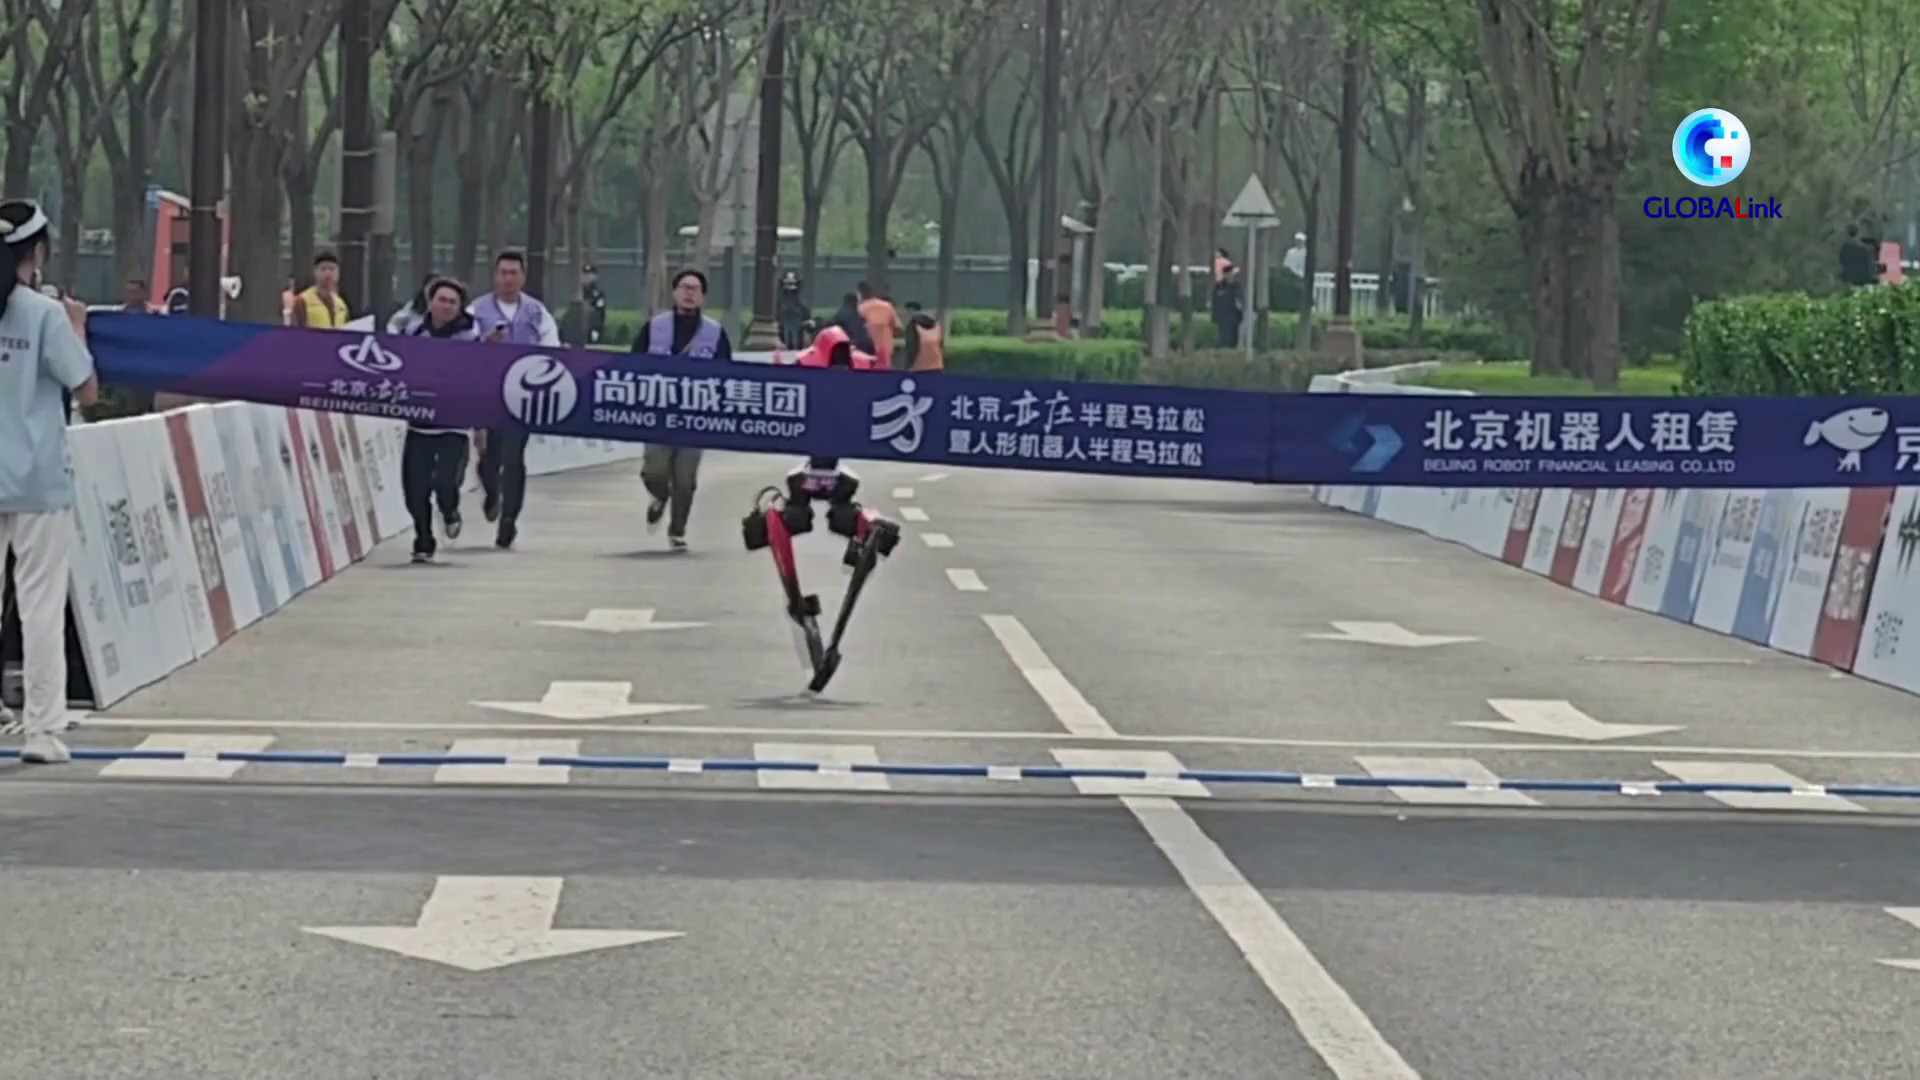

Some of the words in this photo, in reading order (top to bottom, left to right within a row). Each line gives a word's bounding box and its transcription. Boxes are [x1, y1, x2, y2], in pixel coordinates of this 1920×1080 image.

[594, 369, 807, 418] 尚亦城集团
[592, 408, 656, 428] SHANG
[665, 413, 737, 433] E-TOWN
[741, 418, 805, 438] GROUP
[1423, 409, 1738, 452] 北京机器人租赁
[1483, 458, 1531, 472] ROBOT
[1538, 458, 1609, 473] FINANCIAL
[1615, 459, 1674, 473] LEASING
